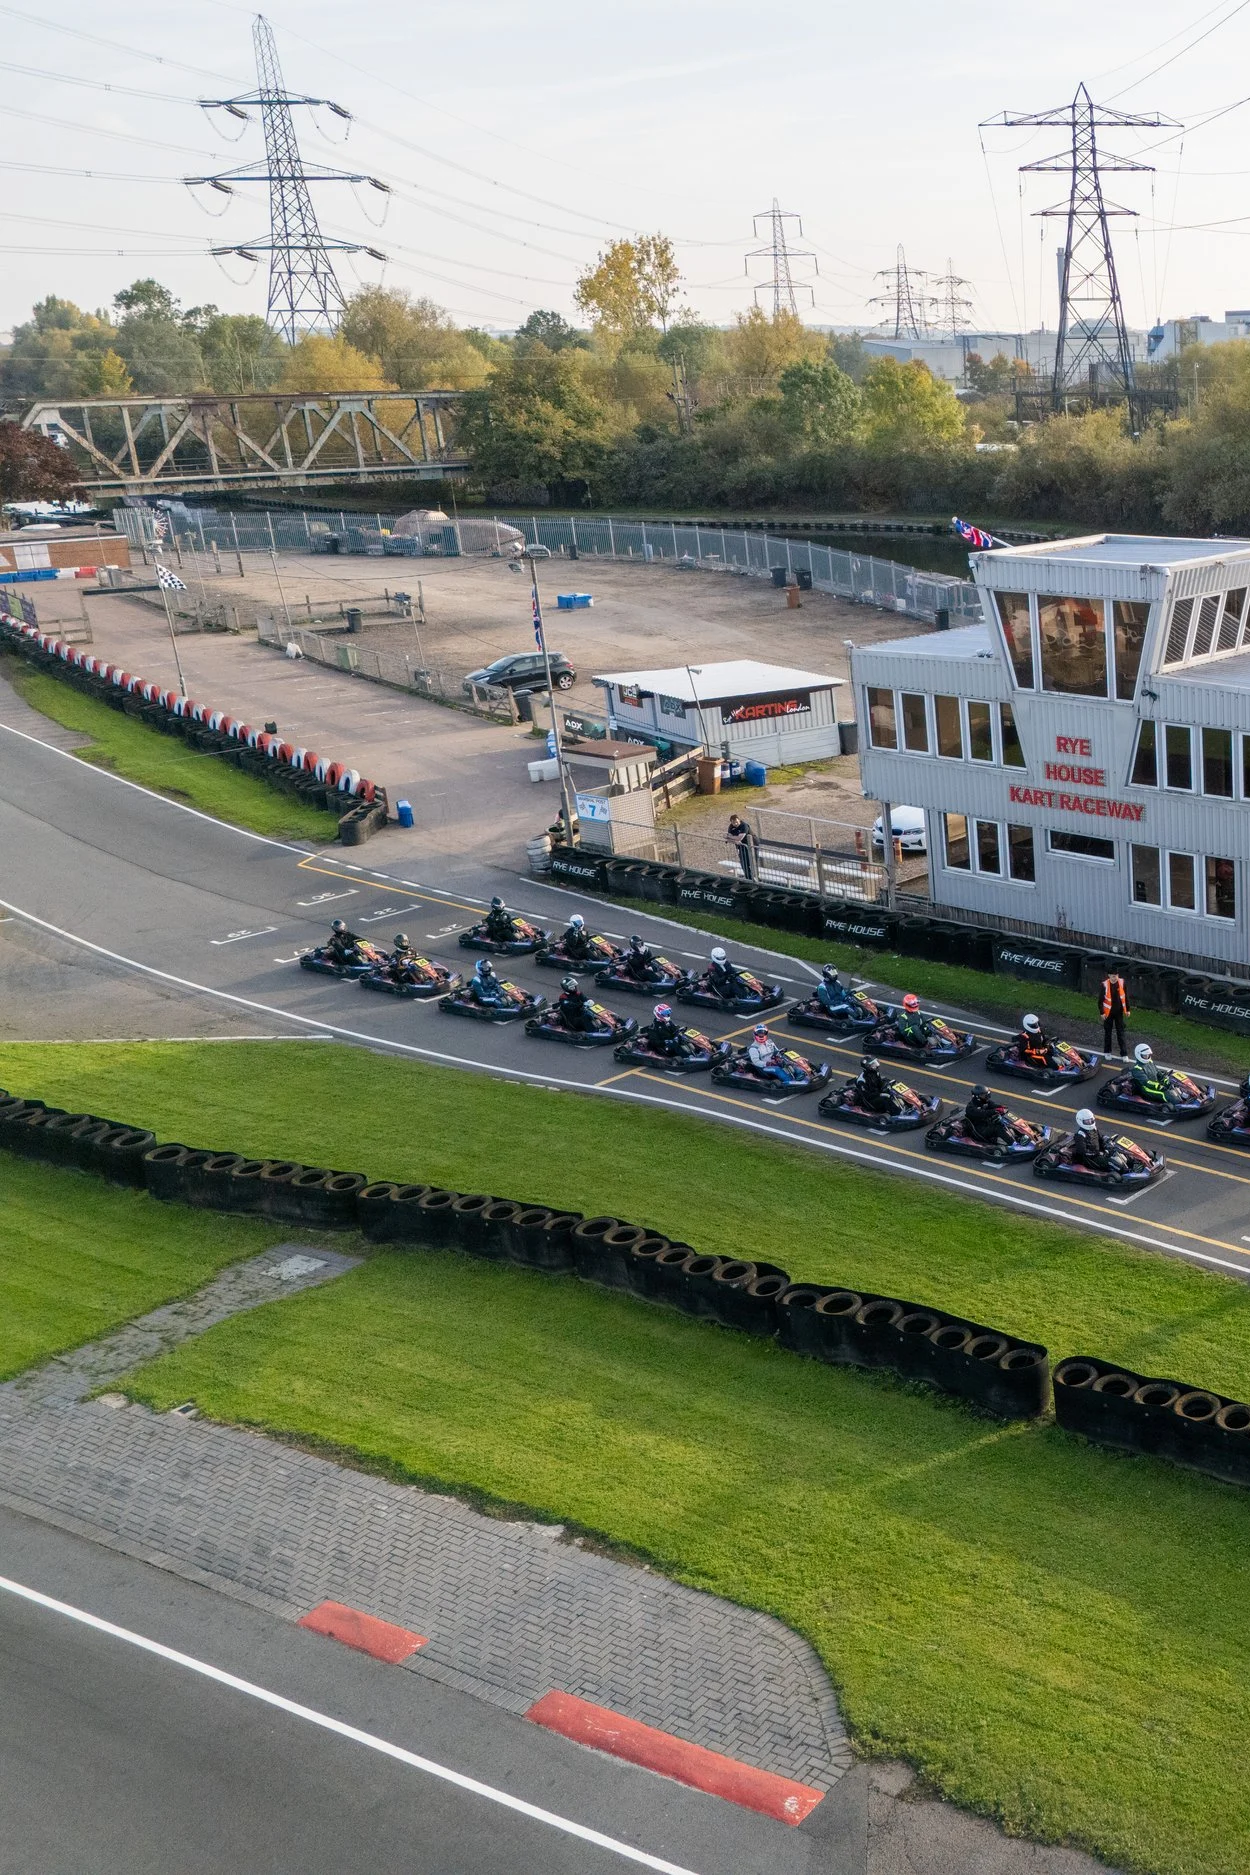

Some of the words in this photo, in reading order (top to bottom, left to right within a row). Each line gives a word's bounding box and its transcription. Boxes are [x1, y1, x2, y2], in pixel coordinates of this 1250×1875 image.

[735, 700, 797, 720] KARTING
[786, 702, 811, 714] London
[565, 719, 583, 731] ADX
[1056, 735, 1092, 757] RYE
[1045, 763, 1107, 787] HOUSE
[588, 804, 596, 817] 7
[1009, 785, 1055, 808] KART
[1059, 794, 1146, 822] RACEWAY
[552, 860, 568, 872] RYE
[568, 865, 597, 878] HOUSE
[680, 889, 701, 899] RYE
[703, 893, 734, 907] HOUSE
[825, 919, 847, 931] RYE
[847, 924, 885, 937] HOUSE
[1000, 951, 1023, 964] RYE
[1024, 957, 1065, 972] HOUSE
[1184, 995, 1209, 1009] RYE
[896, 1083, 906, 1092] 21
